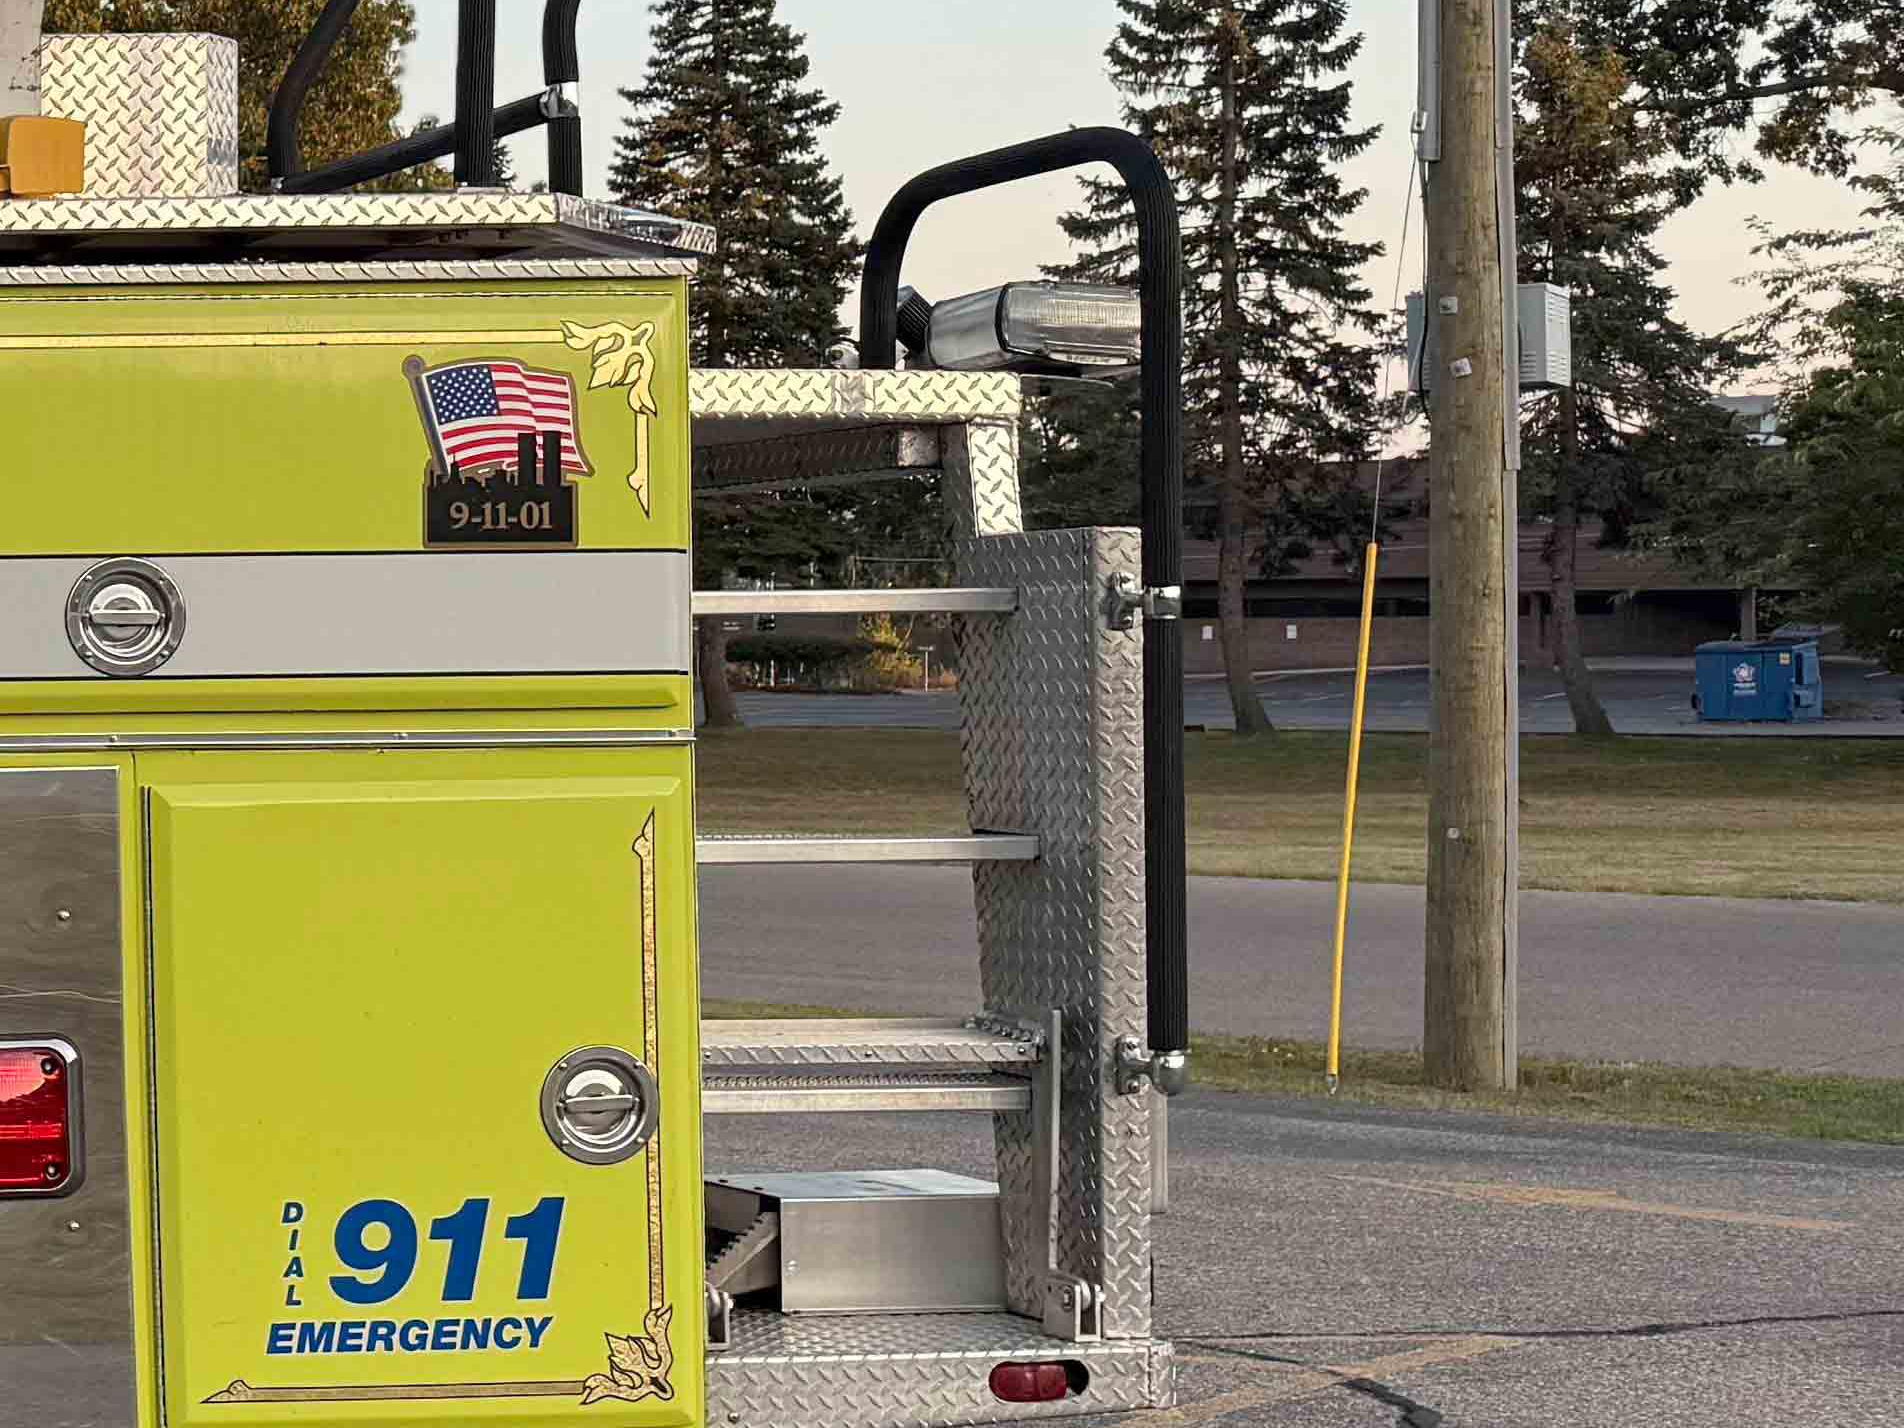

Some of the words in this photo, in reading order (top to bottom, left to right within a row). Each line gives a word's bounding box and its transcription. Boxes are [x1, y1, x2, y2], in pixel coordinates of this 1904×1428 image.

[449, 501, 553, 530] 9-11-01
[281, 1201, 304, 1306] DIAL
[328, 1195, 567, 1305] 911
[265, 1316, 553, 1355] EMERGENCY
